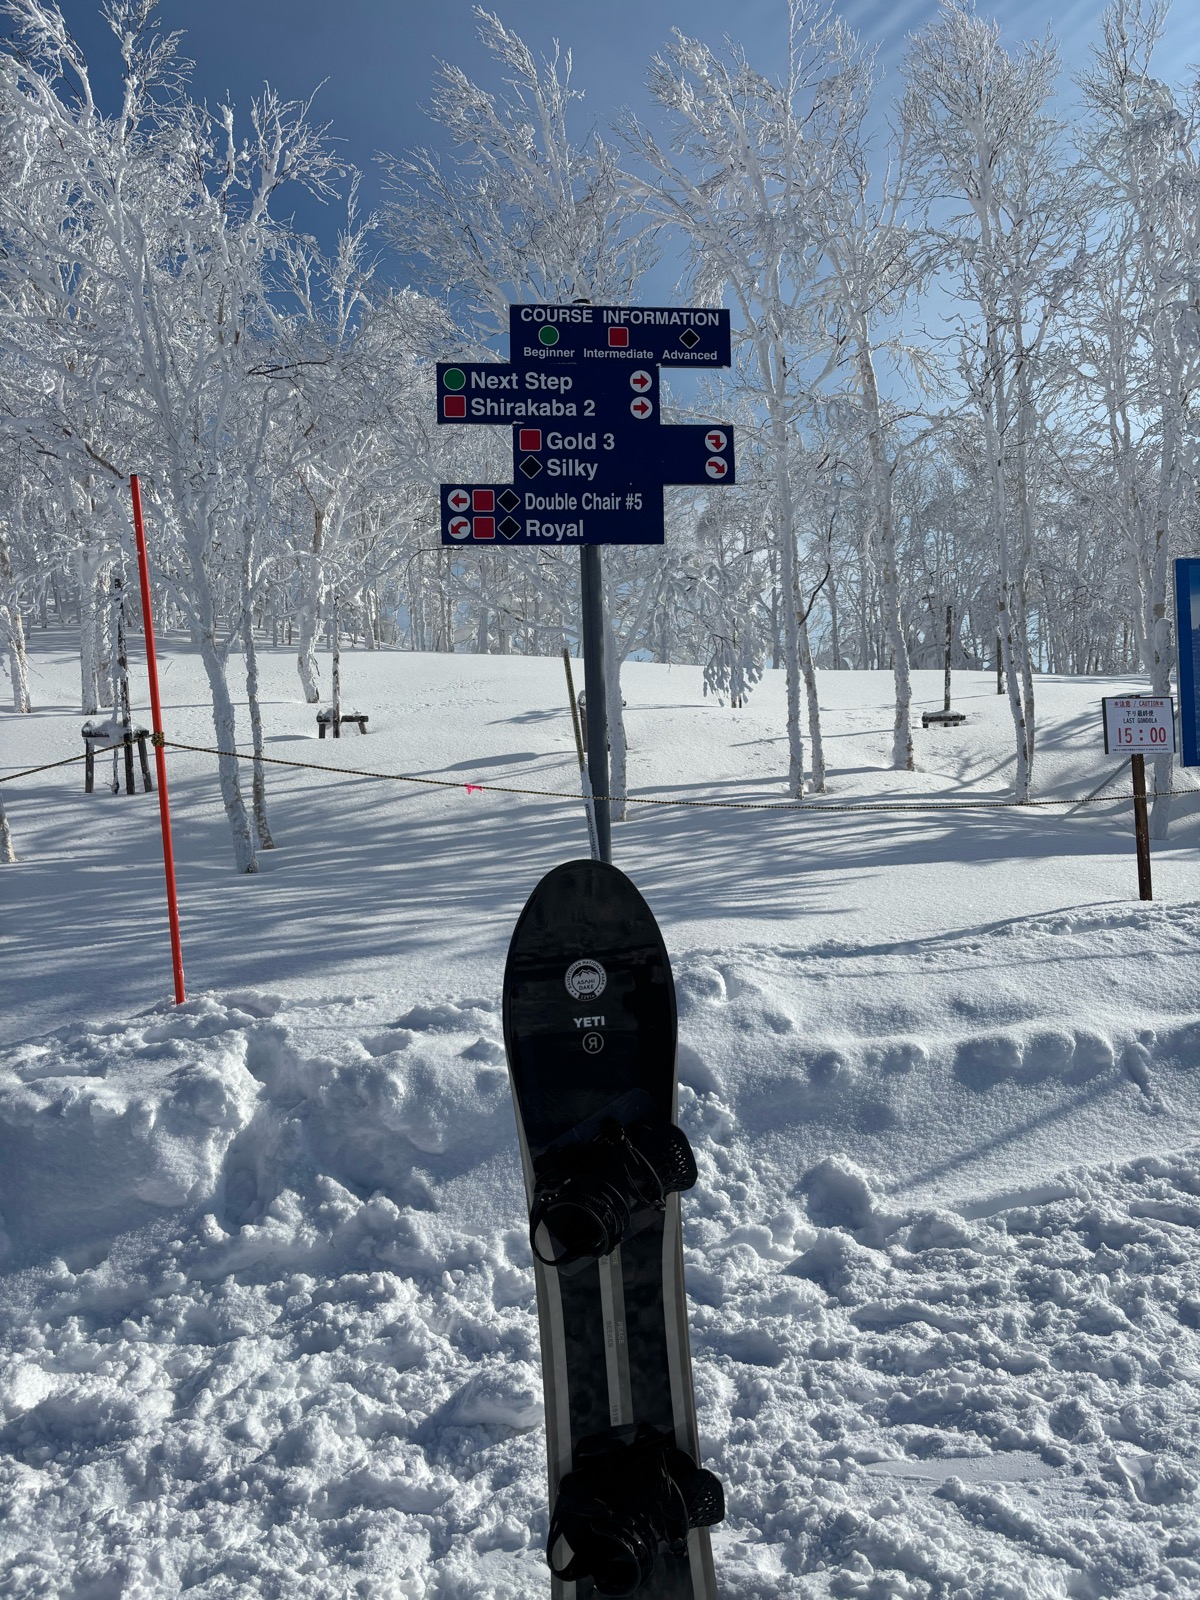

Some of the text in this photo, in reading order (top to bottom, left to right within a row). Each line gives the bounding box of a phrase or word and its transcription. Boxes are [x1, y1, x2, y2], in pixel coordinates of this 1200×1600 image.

[520, 307, 720, 326] COURSE INFORMATION
[523, 346, 575, 360] Beginner
[583, 348, 654, 360] Intermediate
[662, 349, 718, 361] Advanced
[470, 371, 573, 394] Next Step
[470, 398, 596, 417] Shirakaba 2
[546, 432, 615, 450] Gold 3
[546, 459, 599, 481] Silky
[525, 492, 643, 511] Double Chair #5
[526, 519, 584, 541] Royal
[573, 1015, 606, 1028] YETI
